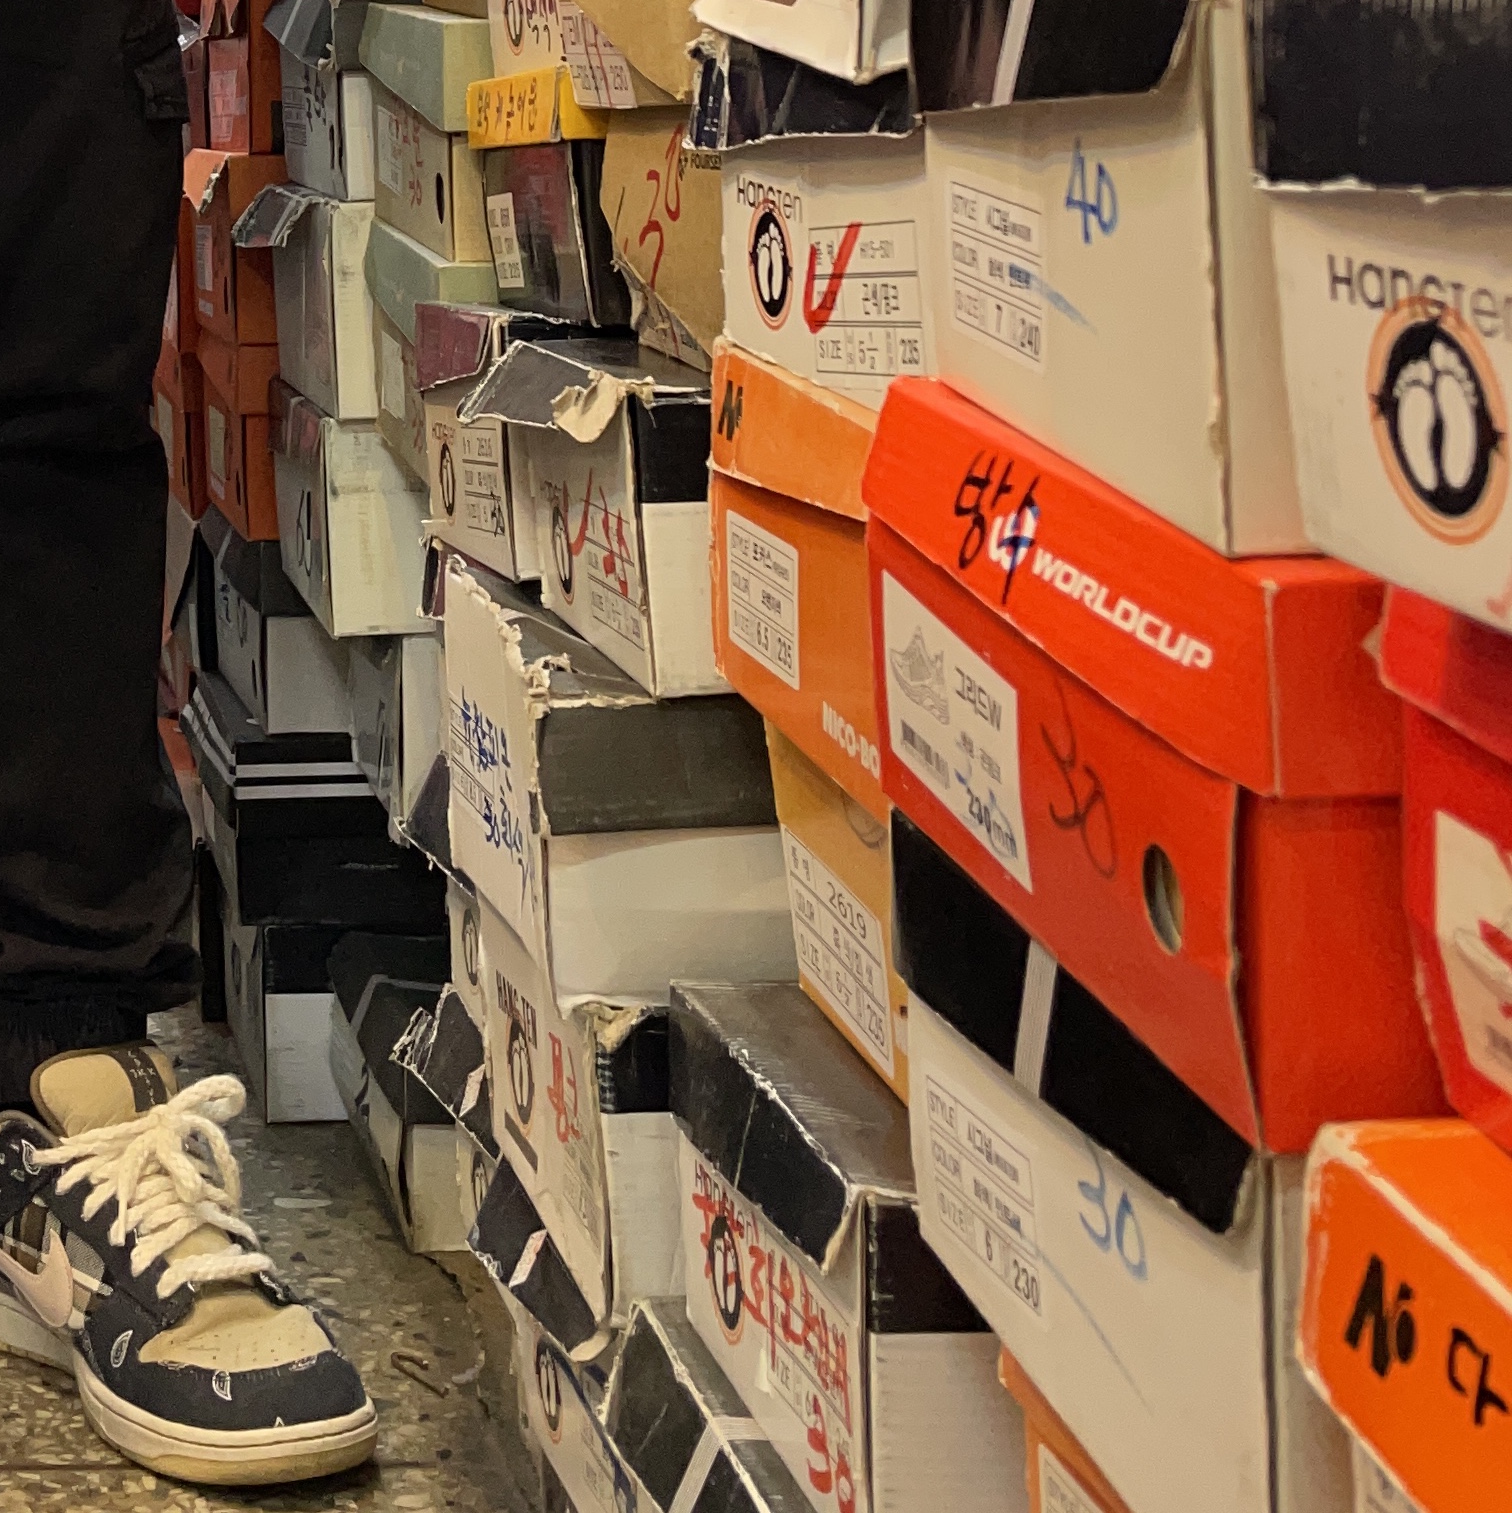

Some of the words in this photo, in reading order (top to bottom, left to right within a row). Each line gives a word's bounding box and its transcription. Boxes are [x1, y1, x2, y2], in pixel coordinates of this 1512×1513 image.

[1065, 138, 1119, 246] 40
[818, 339, 843, 360] SIZE
[1032, 548, 1214, 670] WORLDCUP
[826, 880, 868, 940] 2619
[799, 931, 822, 972] SIZE
[928, 1090, 956, 1132] STYLE
[1012, 1258, 1040, 1308] 230
